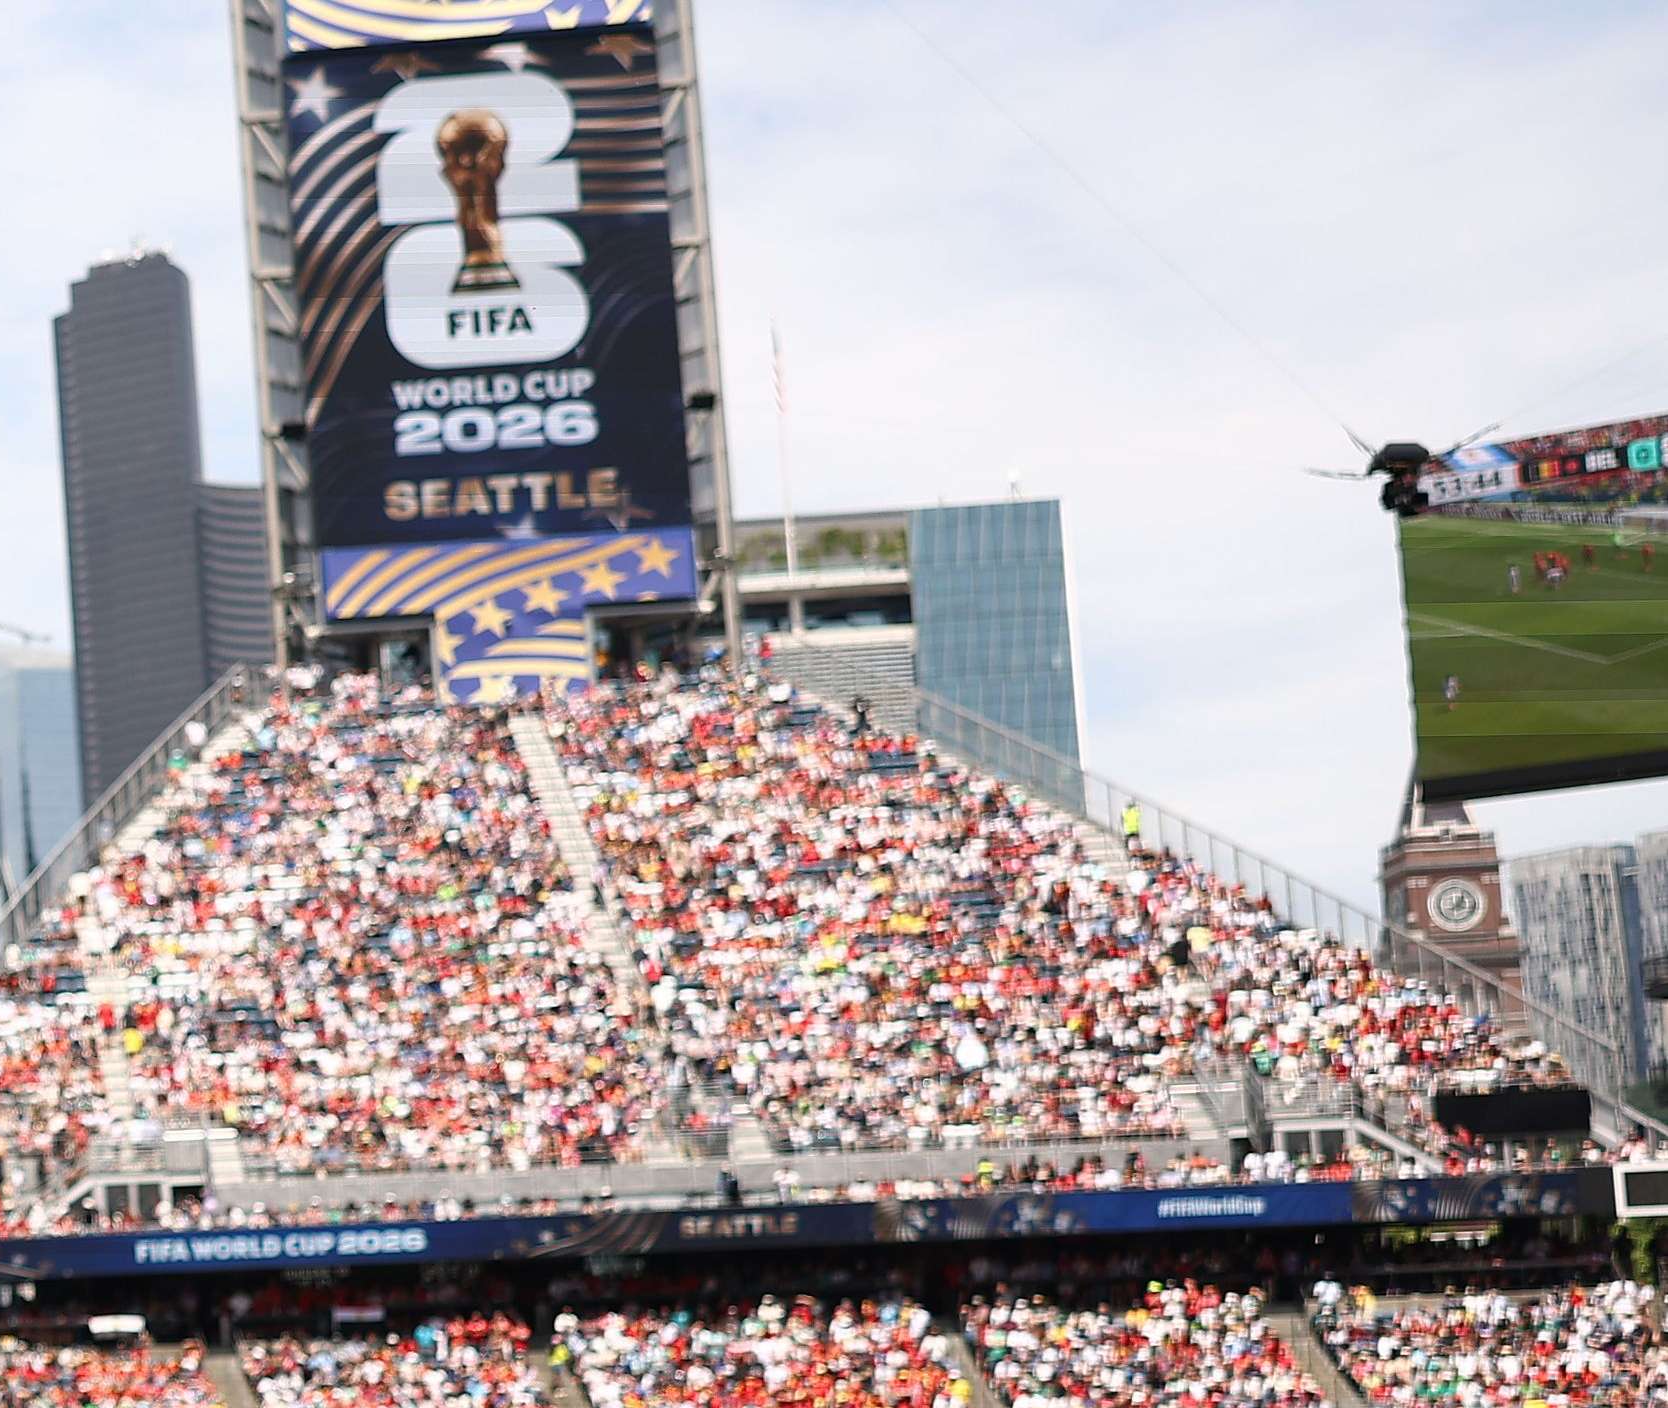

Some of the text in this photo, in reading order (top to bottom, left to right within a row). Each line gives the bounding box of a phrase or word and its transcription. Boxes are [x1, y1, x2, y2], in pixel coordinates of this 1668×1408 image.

[447, 307, 532, 337] FIFA
[392, 367, 596, 411] WORLD CUP
[393, 400, 600, 457] 2026
[384, 467, 619, 522] SEATTLE
[1158, 1195, 1267, 1218] #FIFAWorldCup
[678, 1212, 799, 1238] SEATTLE
[134, 1227, 427, 1263] FIFA WORLD CUP 2026
